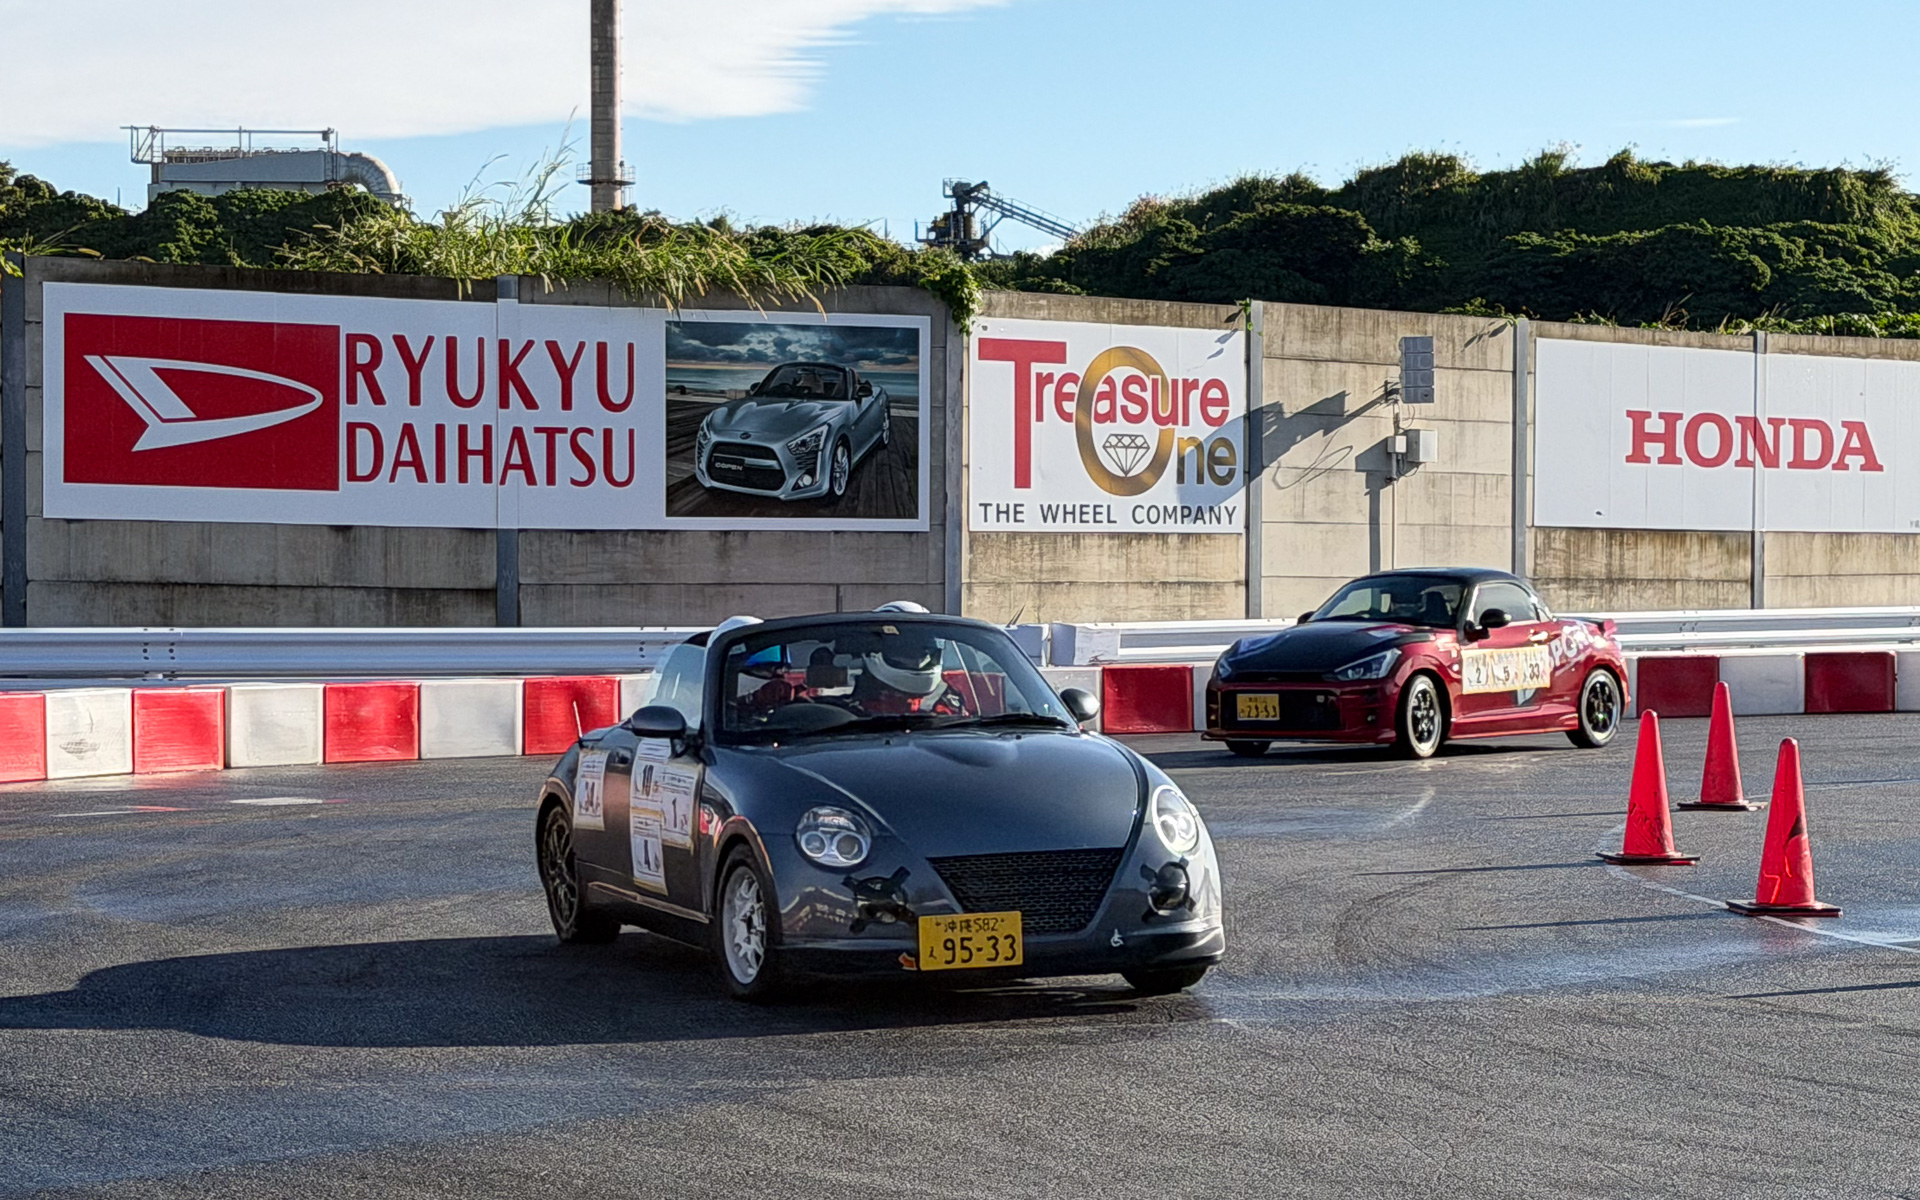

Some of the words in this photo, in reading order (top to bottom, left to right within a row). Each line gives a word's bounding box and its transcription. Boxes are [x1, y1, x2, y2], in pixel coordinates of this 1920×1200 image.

[345, 333, 634, 413] RYUKYU
[977, 337, 1230, 489] Treasure
[1075, 346, 1237, 496] One
[1625, 410, 1884, 473] HONDA
[346, 422, 635, 488] DAIHATSU
[979, 503, 1025, 523] THE
[1040, 504, 1117, 524] WHEEL
[1132, 504, 1237, 525] COMPANY
[942, 934, 1017, 964] 95-33
